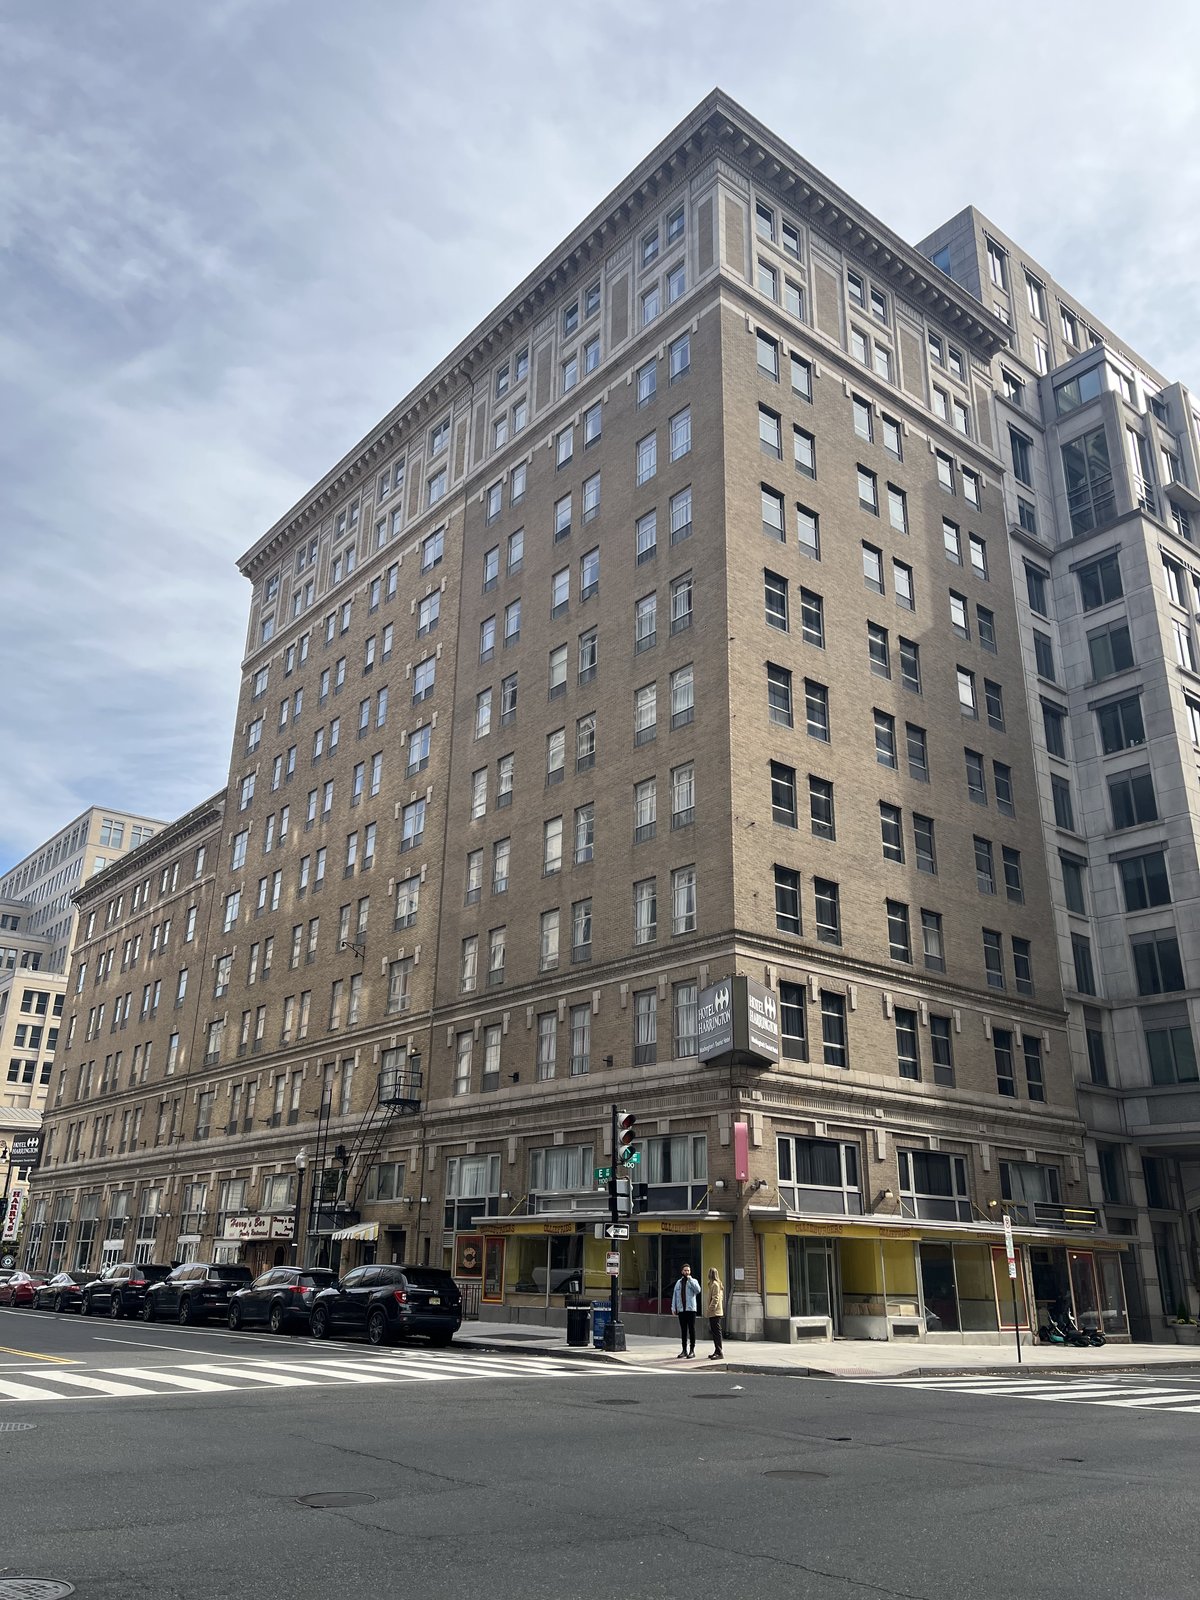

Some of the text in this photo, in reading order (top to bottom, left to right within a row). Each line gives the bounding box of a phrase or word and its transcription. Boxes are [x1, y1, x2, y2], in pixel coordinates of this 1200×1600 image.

[698, 1003, 715, 1021] HOTEL
[749, 994, 765, 1015] HOTEL
[698, 1009, 731, 1035] HARRINGTON
[749, 1009, 778, 1036] HARRINGTON
[598, 1169, 603, 1178] E
[230, 1216, 265, 1230] Harry's Bar
